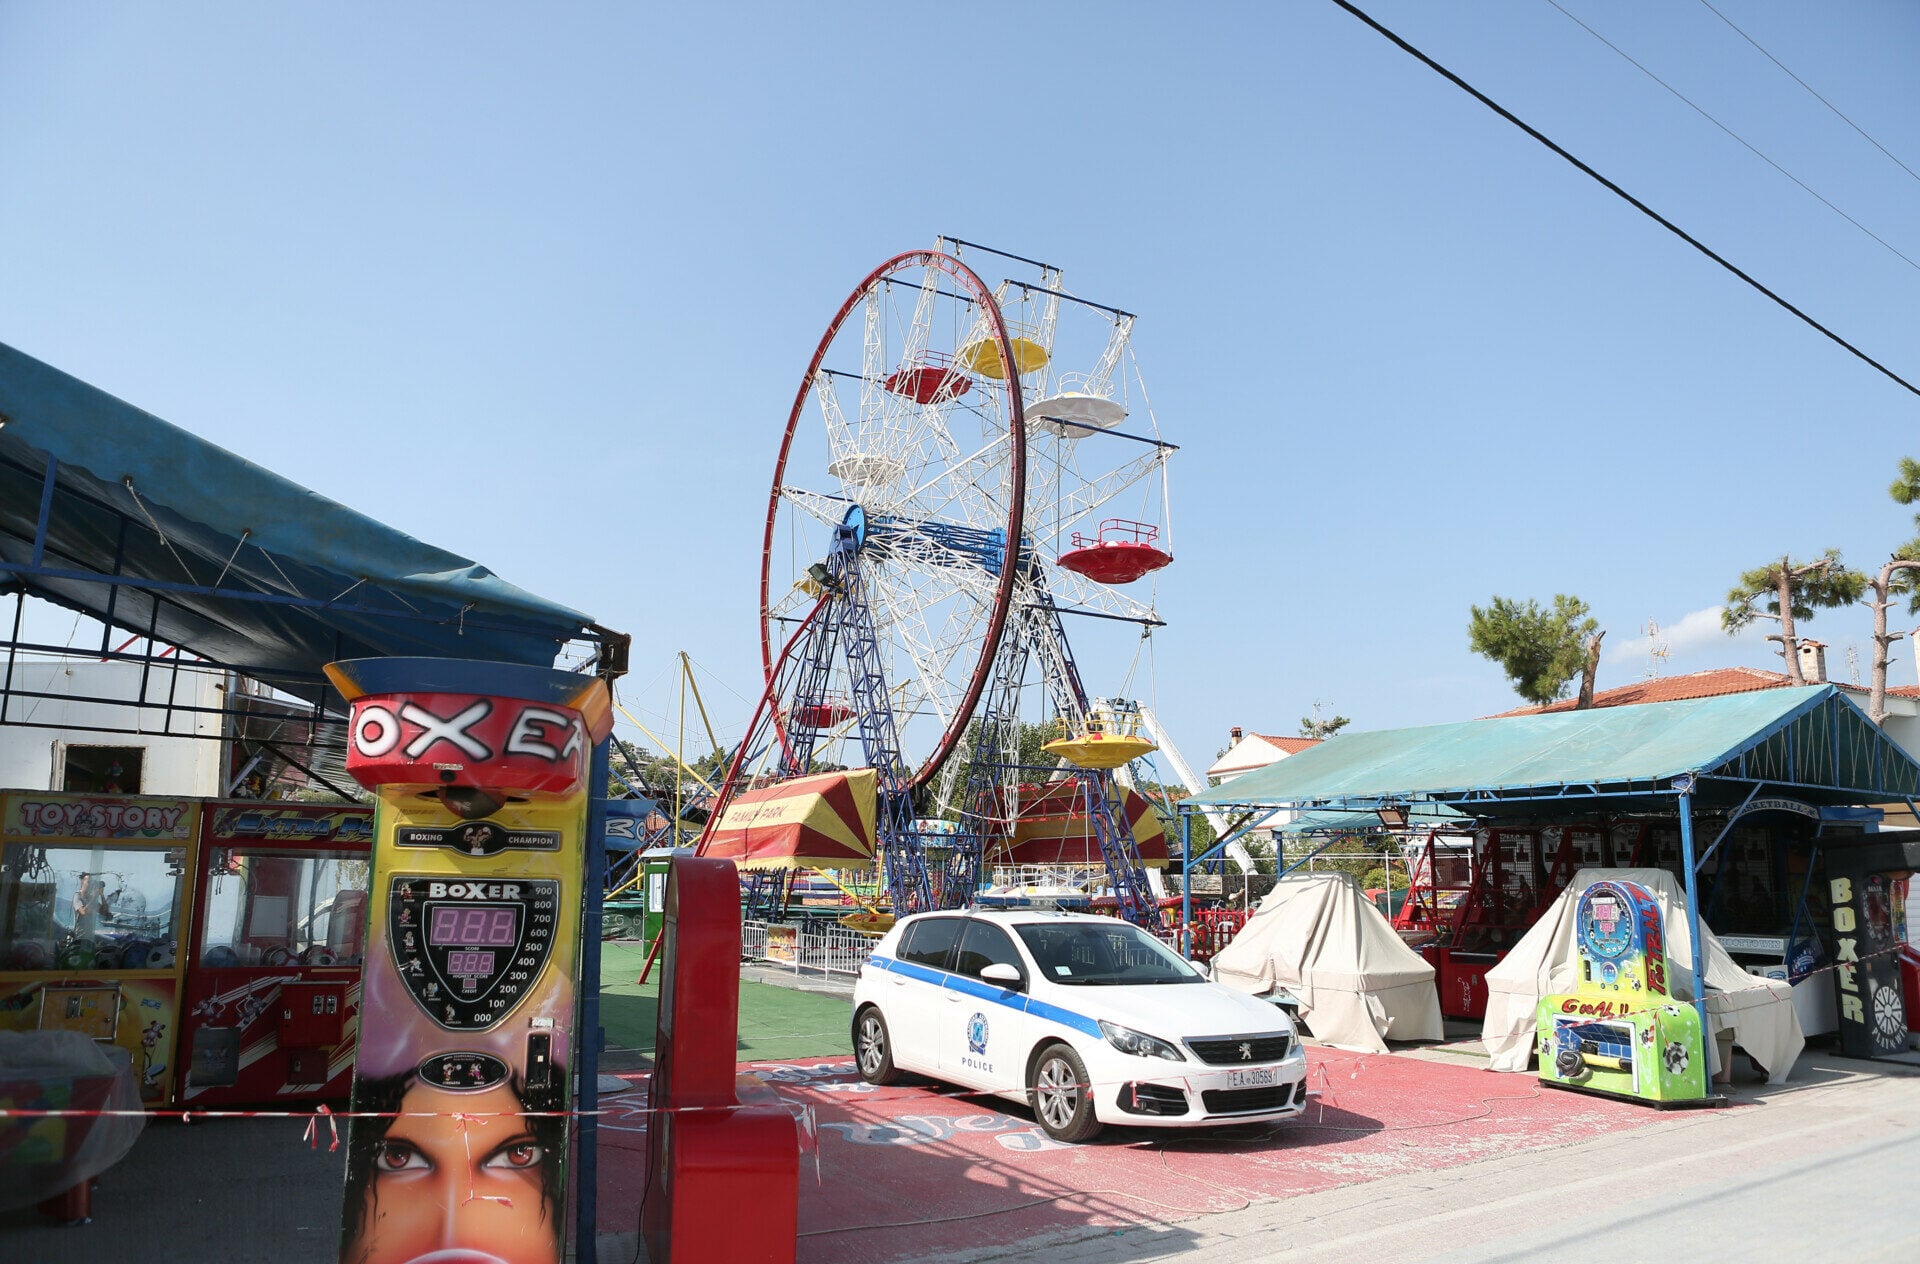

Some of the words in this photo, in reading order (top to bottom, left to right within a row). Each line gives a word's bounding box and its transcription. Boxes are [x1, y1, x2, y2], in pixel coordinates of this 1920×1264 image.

[22, 803, 83, 827] TOY
[90, 805, 181, 830] STORY
[760, 804, 788, 820] PARK
[234, 813, 331, 836] EXTRA
[410, 833, 442, 842] BOXING
[508, 836, 554, 845] CHAMPION
[429, 883, 520, 899] BOXER
[535, 887, 552, 895] 900
[534, 901, 551, 909] 800
[534, 915, 551, 923] 700
[530, 928, 548, 937] 600
[525, 943, 542, 952] 500
[1830, 877, 1864, 1024] BOXER
[517, 957, 535, 966] 400
[510, 971, 528, 980] 300
[500, 985, 517, 994] 200
[489, 999, 506, 1008] 100
[474, 1013, 491, 1022] 000
[961, 1057, 994, 1073] POLICE
